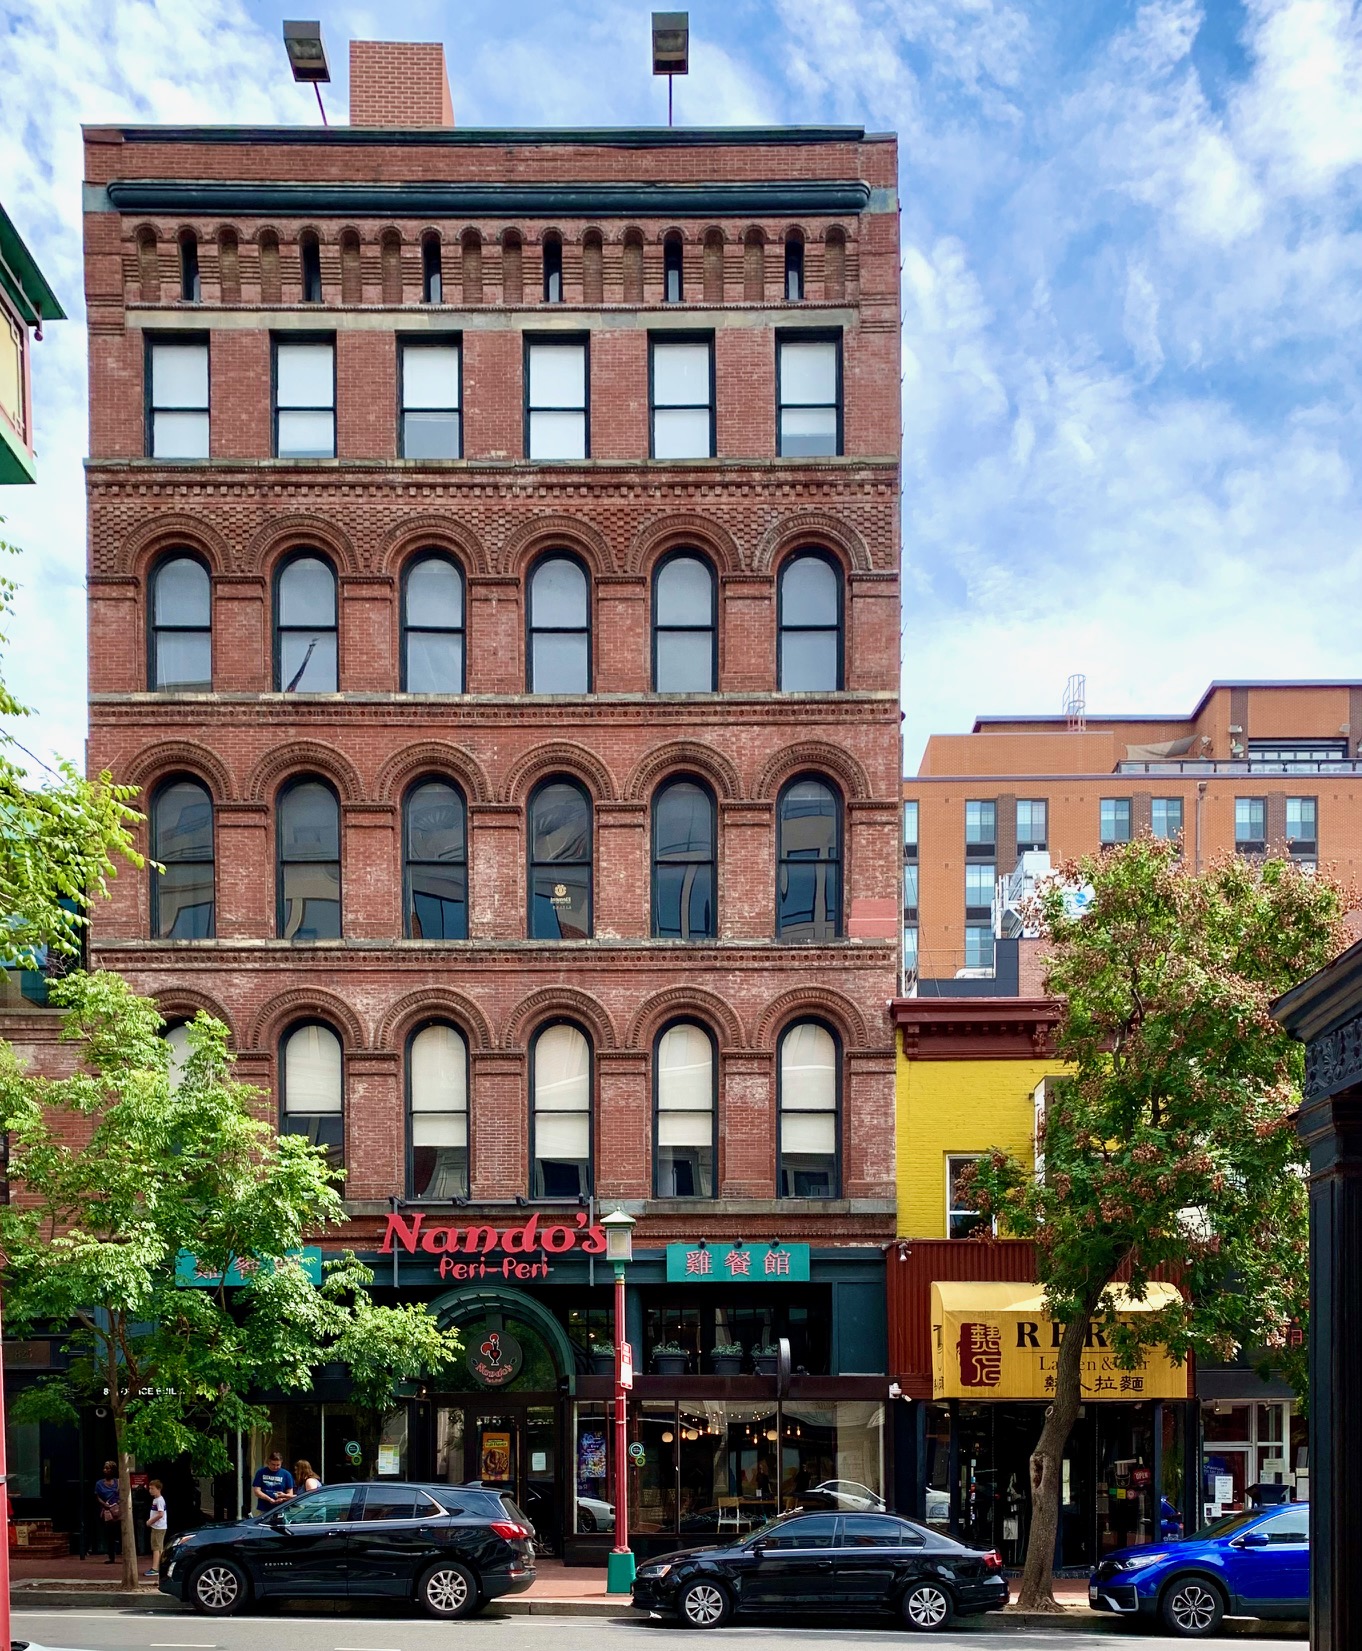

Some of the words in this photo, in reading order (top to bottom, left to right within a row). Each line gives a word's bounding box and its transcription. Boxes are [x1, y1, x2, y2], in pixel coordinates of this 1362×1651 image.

[377, 1211, 607, 1254] Nando's
[439, 1256, 548, 1280] Peri-Peri
[685, 1249, 791, 1276] 雞餐館
[1016, 1321, 1162, 1348] RER
[1039, 1356, 1096, 1370] Laen
[1101, 1356, 1114, 1370] &
